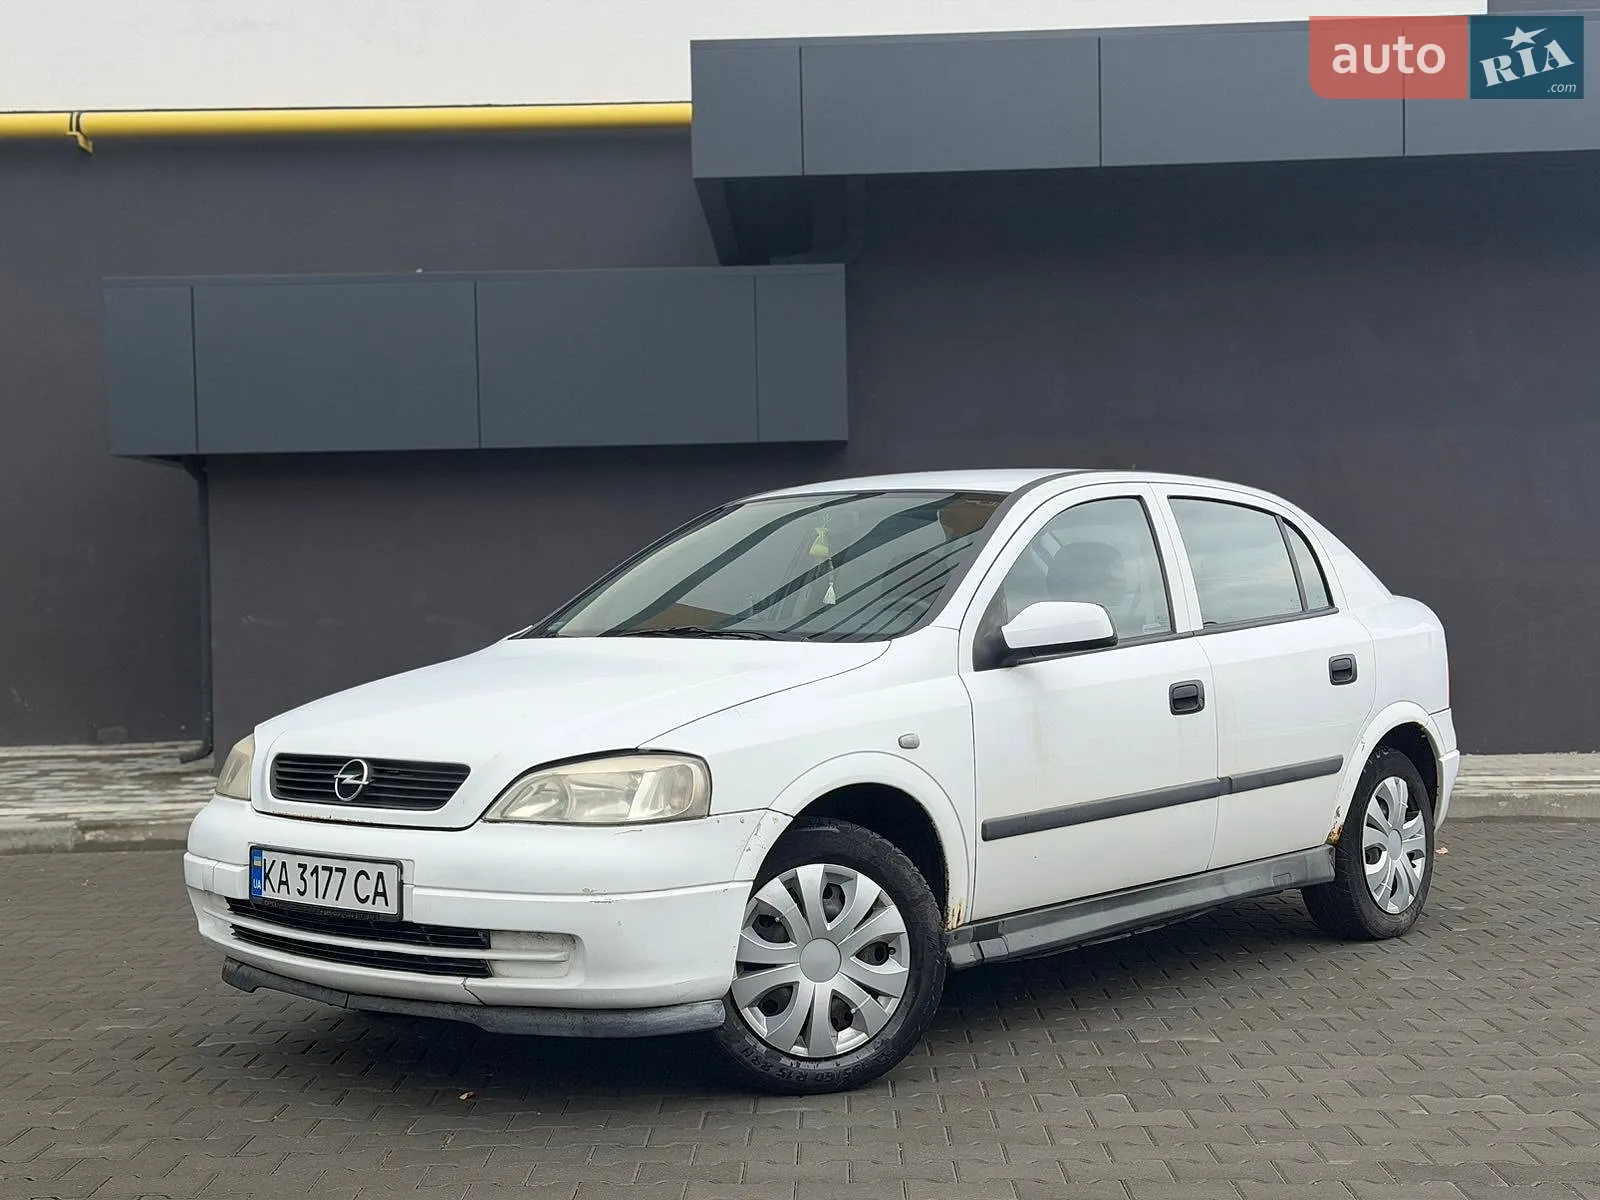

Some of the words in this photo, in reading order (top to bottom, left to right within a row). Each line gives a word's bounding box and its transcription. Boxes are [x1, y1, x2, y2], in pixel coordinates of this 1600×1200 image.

[253, 878, 262, 890] UA
[263, 858, 290, 895] KA
[296, 862, 346, 901] 3177
[353, 869, 389, 907] CA
